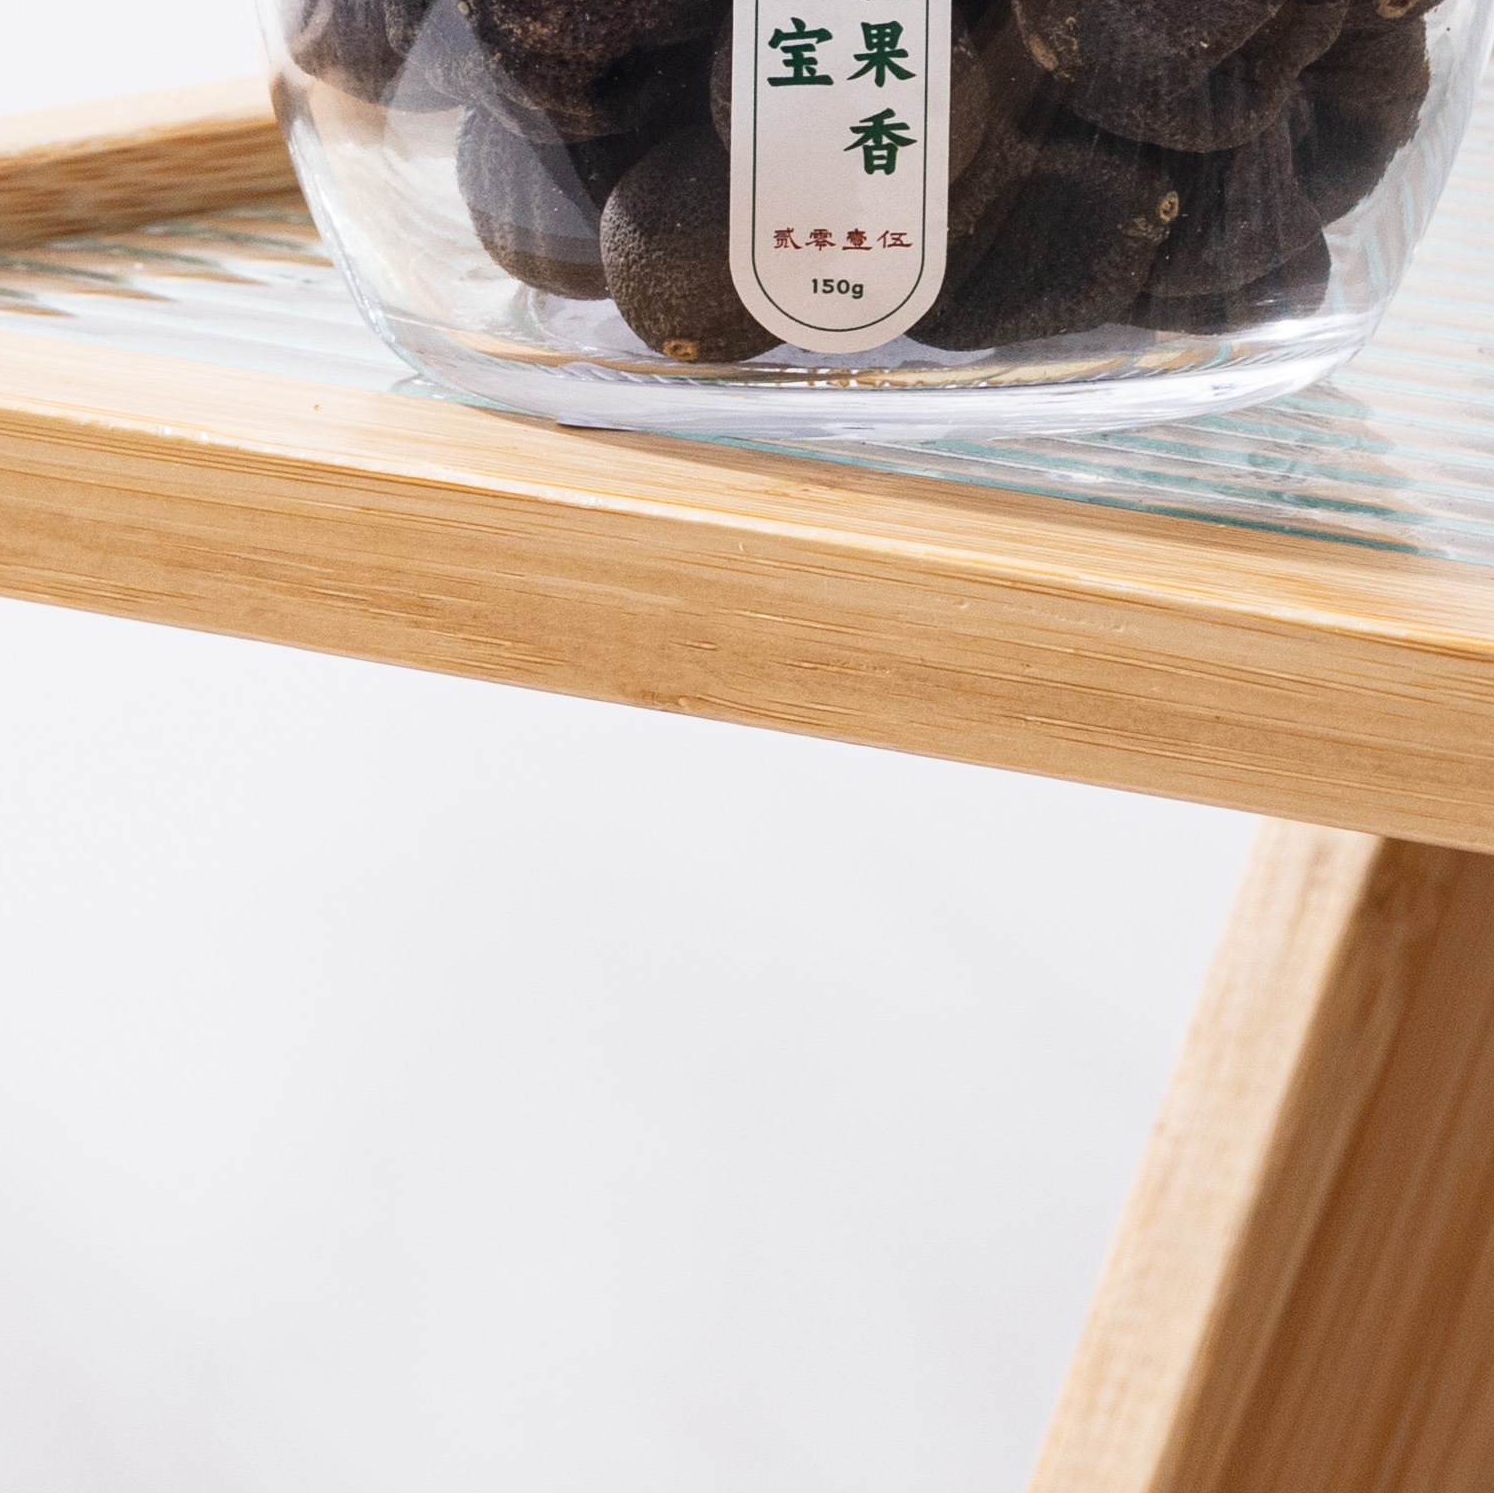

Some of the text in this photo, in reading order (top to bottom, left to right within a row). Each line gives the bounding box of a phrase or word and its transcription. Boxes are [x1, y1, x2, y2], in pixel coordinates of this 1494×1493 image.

[773, 226, 913, 252] 贰零壹伍
[811, 278, 864, 300] 150g
